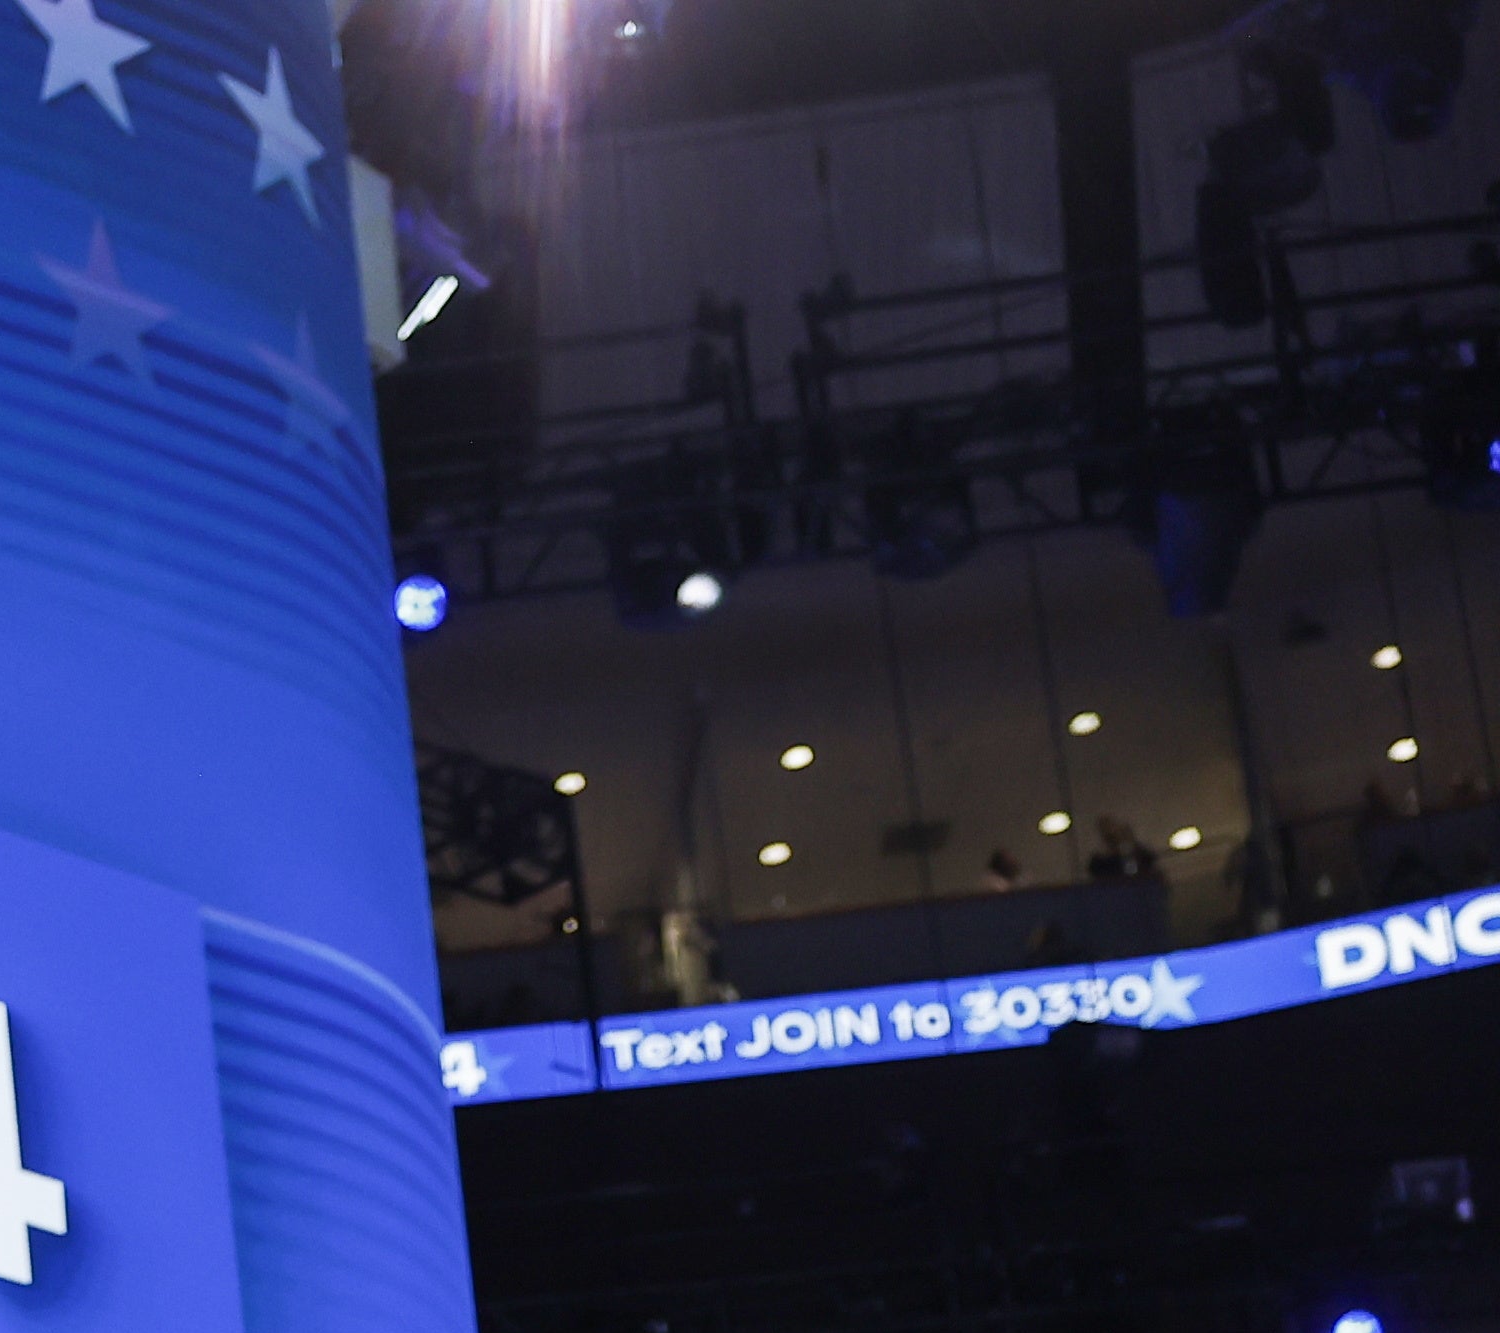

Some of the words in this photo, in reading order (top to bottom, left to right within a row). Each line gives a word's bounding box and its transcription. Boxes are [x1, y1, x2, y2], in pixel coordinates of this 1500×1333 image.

[1315, 893, 1500, 990] DNC
[601, 1021, 727, 1071] Text
[735, 1003, 880, 1058] JOIN
[889, 1003, 951, 1042] to
[961, 974, 1152, 1034] 30330
